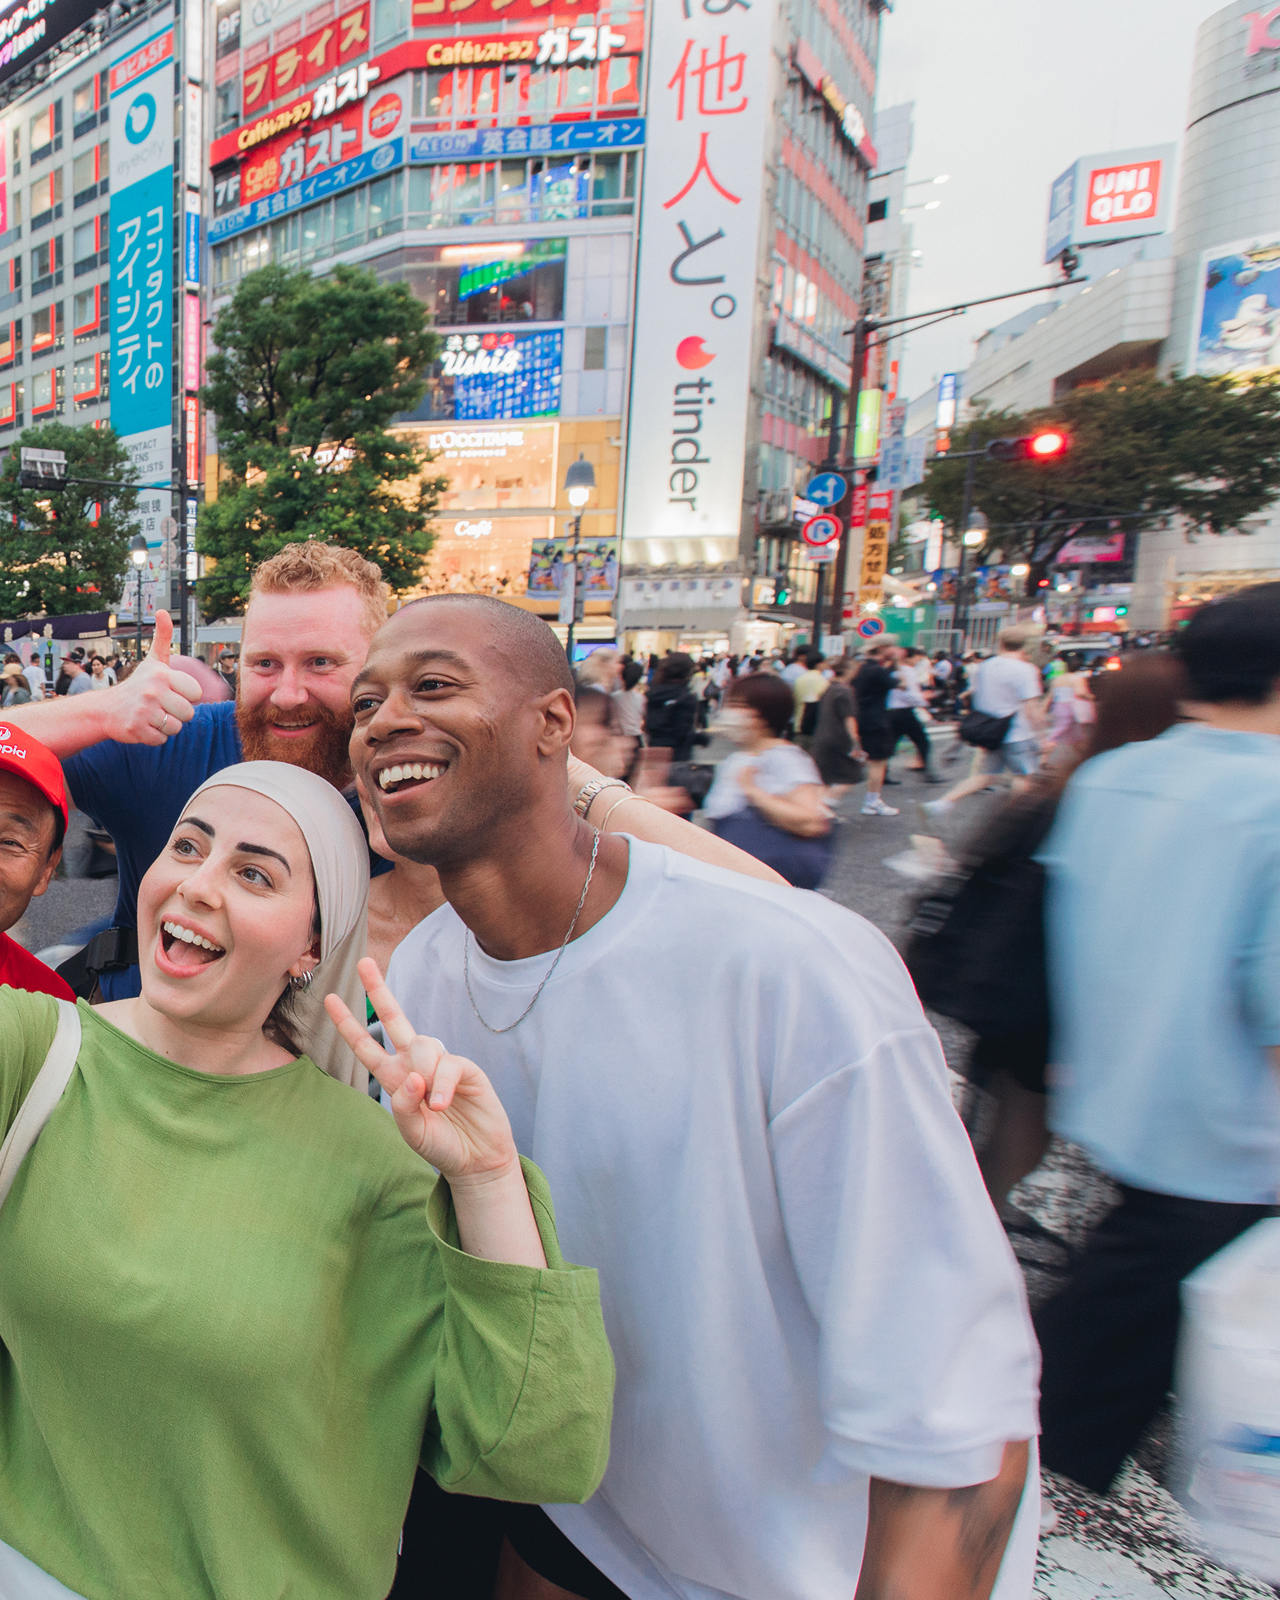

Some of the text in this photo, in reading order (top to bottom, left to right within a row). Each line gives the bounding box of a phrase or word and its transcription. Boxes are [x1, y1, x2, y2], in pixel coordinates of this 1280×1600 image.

[218, 10, 240, 43] 9F
[536, 25, 626, 65] ガスト
[312, 62, 380, 120] ガスト
[482, 123, 642, 150] 英会話イーオン
[279, 122, 357, 189] ガスト
[662, 0, 750, 318] 他人と。
[214, 174, 241, 208] 7F
[256, 160, 366, 221] 英会話イーオン
[1092, 167, 1151, 196] UNI
[1089, 191, 1153, 222] QLO
[116, 215, 142, 395] アイシティ
[144, 205, 164, 389] コンタクトの
[123, 438, 158, 452] ONTACT
[428, 431, 524, 449] L'OCCITANE
[669, 376, 716, 512] tinder
[453, 520, 493, 540] Café
